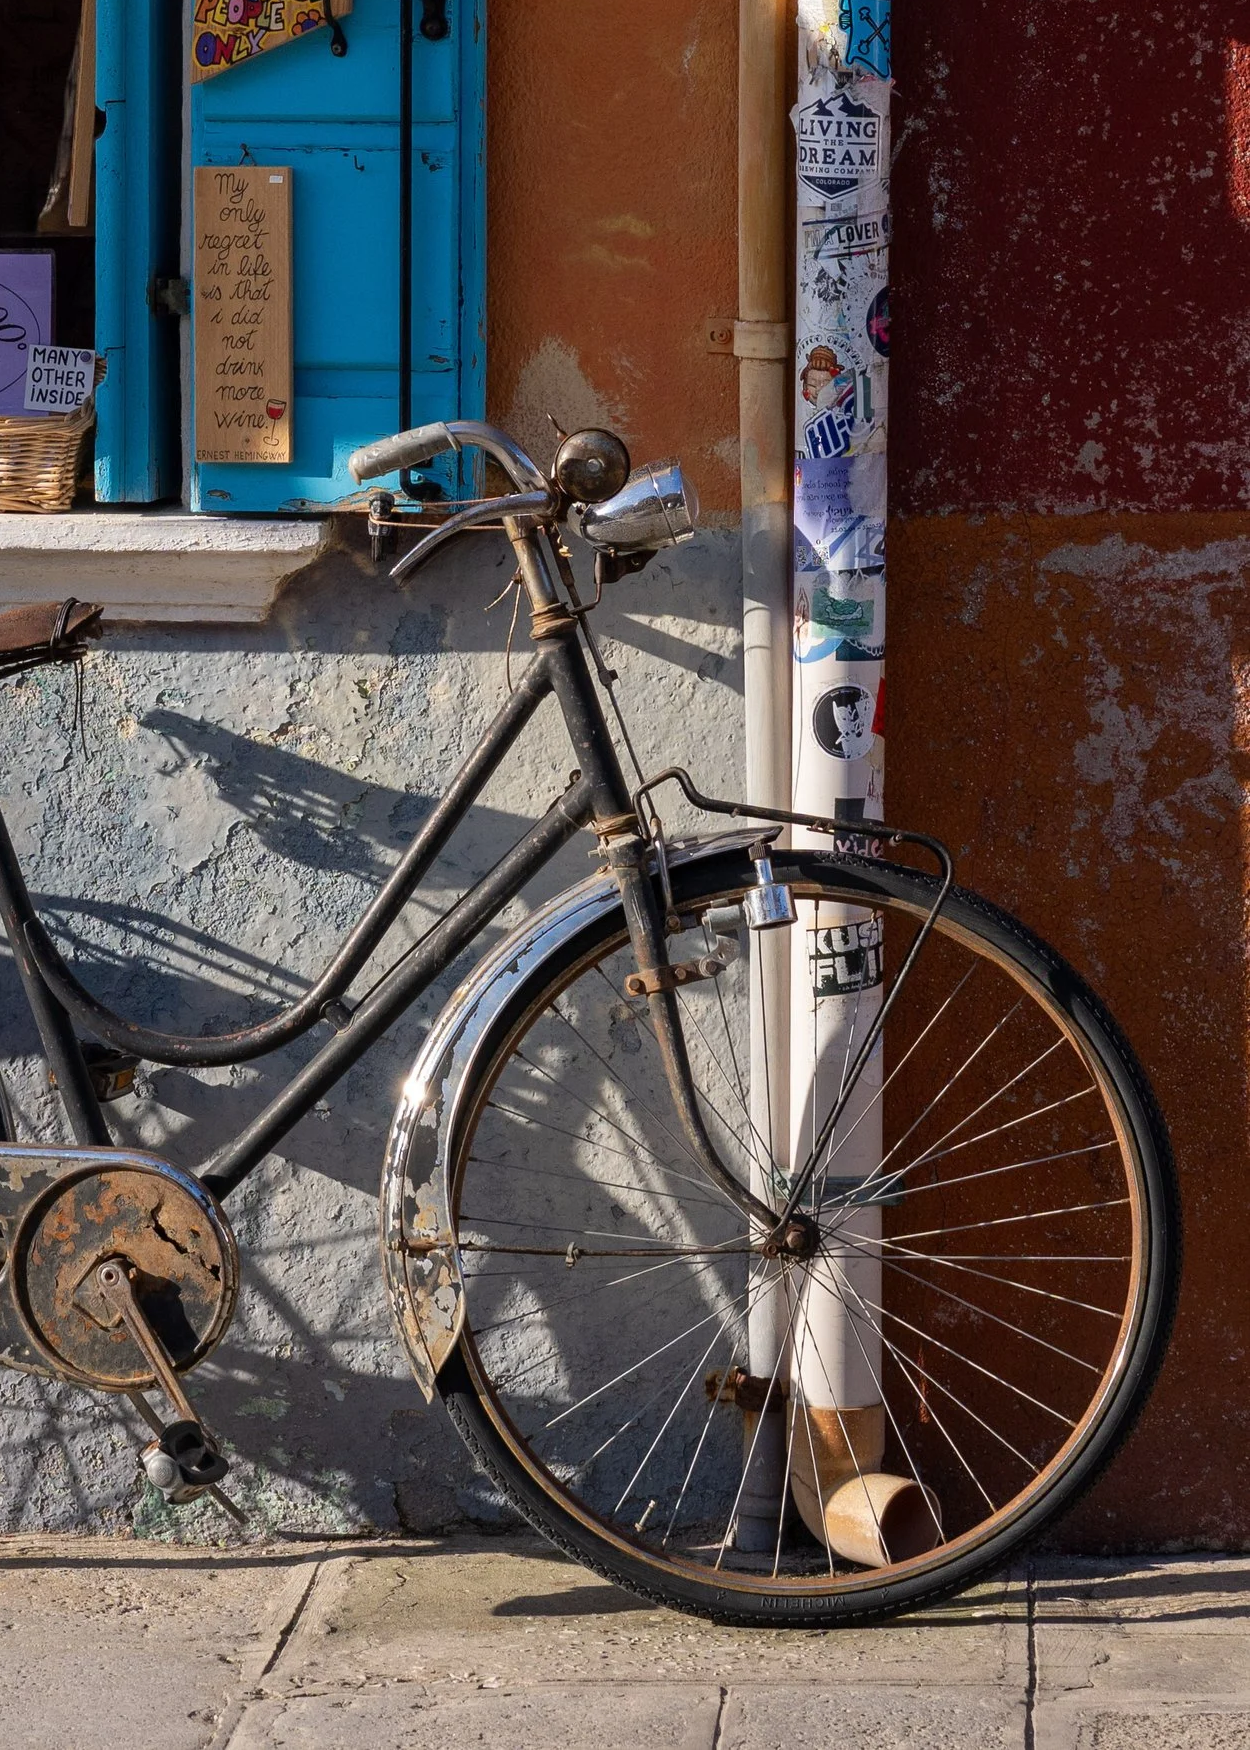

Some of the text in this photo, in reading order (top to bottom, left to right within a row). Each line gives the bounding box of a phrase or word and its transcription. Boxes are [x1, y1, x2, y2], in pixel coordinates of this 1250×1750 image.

[195, 27, 267, 67] ONLY
[800, 118, 877, 138] LIVING
[823, 139, 844, 147] THE
[799, 146, 877, 166] DREAM
[214, 172, 249, 203] My
[815, 178, 851, 186] COLORADO
[219, 198, 266, 232] only
[837, 221, 880, 244] LOVER
[198, 230, 270, 260] regret
[207, 253, 272, 283] in life
[205, 277, 275, 302] is that
[230, 305, 264, 325] did
[220, 329, 259, 351] not
[32, 347, 80, 365] MANY
[215, 356, 265, 377] drink
[31, 369, 86, 388] OTHER
[215, 385, 266, 401] more
[196, 449, 288, 462] ERNEST HEMINGWAY
